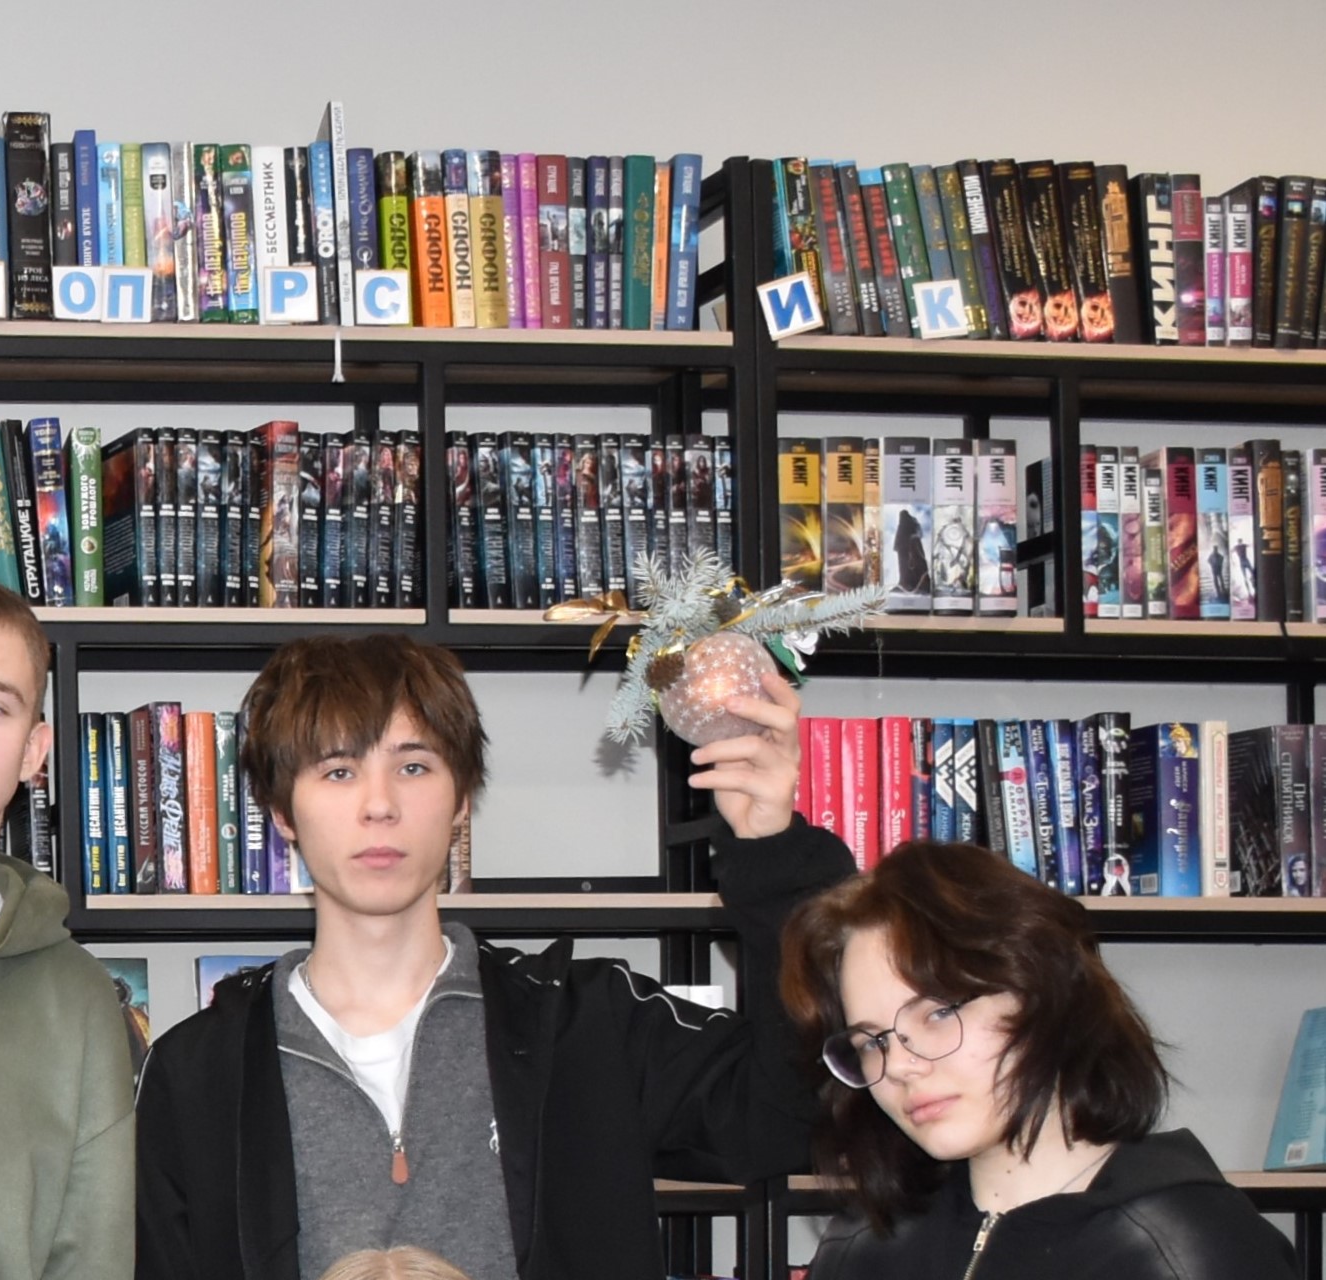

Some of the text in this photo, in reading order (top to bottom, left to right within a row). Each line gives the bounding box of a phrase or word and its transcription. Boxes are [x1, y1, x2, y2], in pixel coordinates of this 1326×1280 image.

[263, 162, 277, 254] БЕССМЕРТНИК
[452, 211, 471, 290] САФОН
[1208, 215, 1222, 249] КИНГ
[1232, 215, 1248, 249] КИНГ
[425, 213, 447, 293] САФОН
[479, 212, 500, 293] САФОН
[1145, 194, 1179, 341] КИНГ
[58, 271, 96, 313] О
[107, 274, 145, 319] П
[270, 271, 308, 314] Р
[362, 277, 401, 318] С
[769, 281, 815, 331] И
[920, 286, 959, 329] К
[792, 457, 807, 486] КИНГ
[838, 455, 852, 485] КИНГ
[865, 456, 878, 486] КИНГ
[899, 457, 915, 490] КИНГ
[945, 458, 962, 491] КИНГ
[990, 457, 1005, 486] КИНГ
[1100, 465, 1114, 492] КИНГ
[1124, 464, 1137, 500] КИНГ
[1204, 465, 1217, 492] КИНГ
[1232, 465, 1249, 503] КИНГ
[1147, 491, 1162, 524] КИНГ
[17, 509, 40, 598] СТРУГАЦКИЕ
[88, 787, 102, 838] ДЕСАНТНИК
[113, 786, 126, 836] ДЕСАНТНИК
[1292, 783, 1307, 812] ПИР
